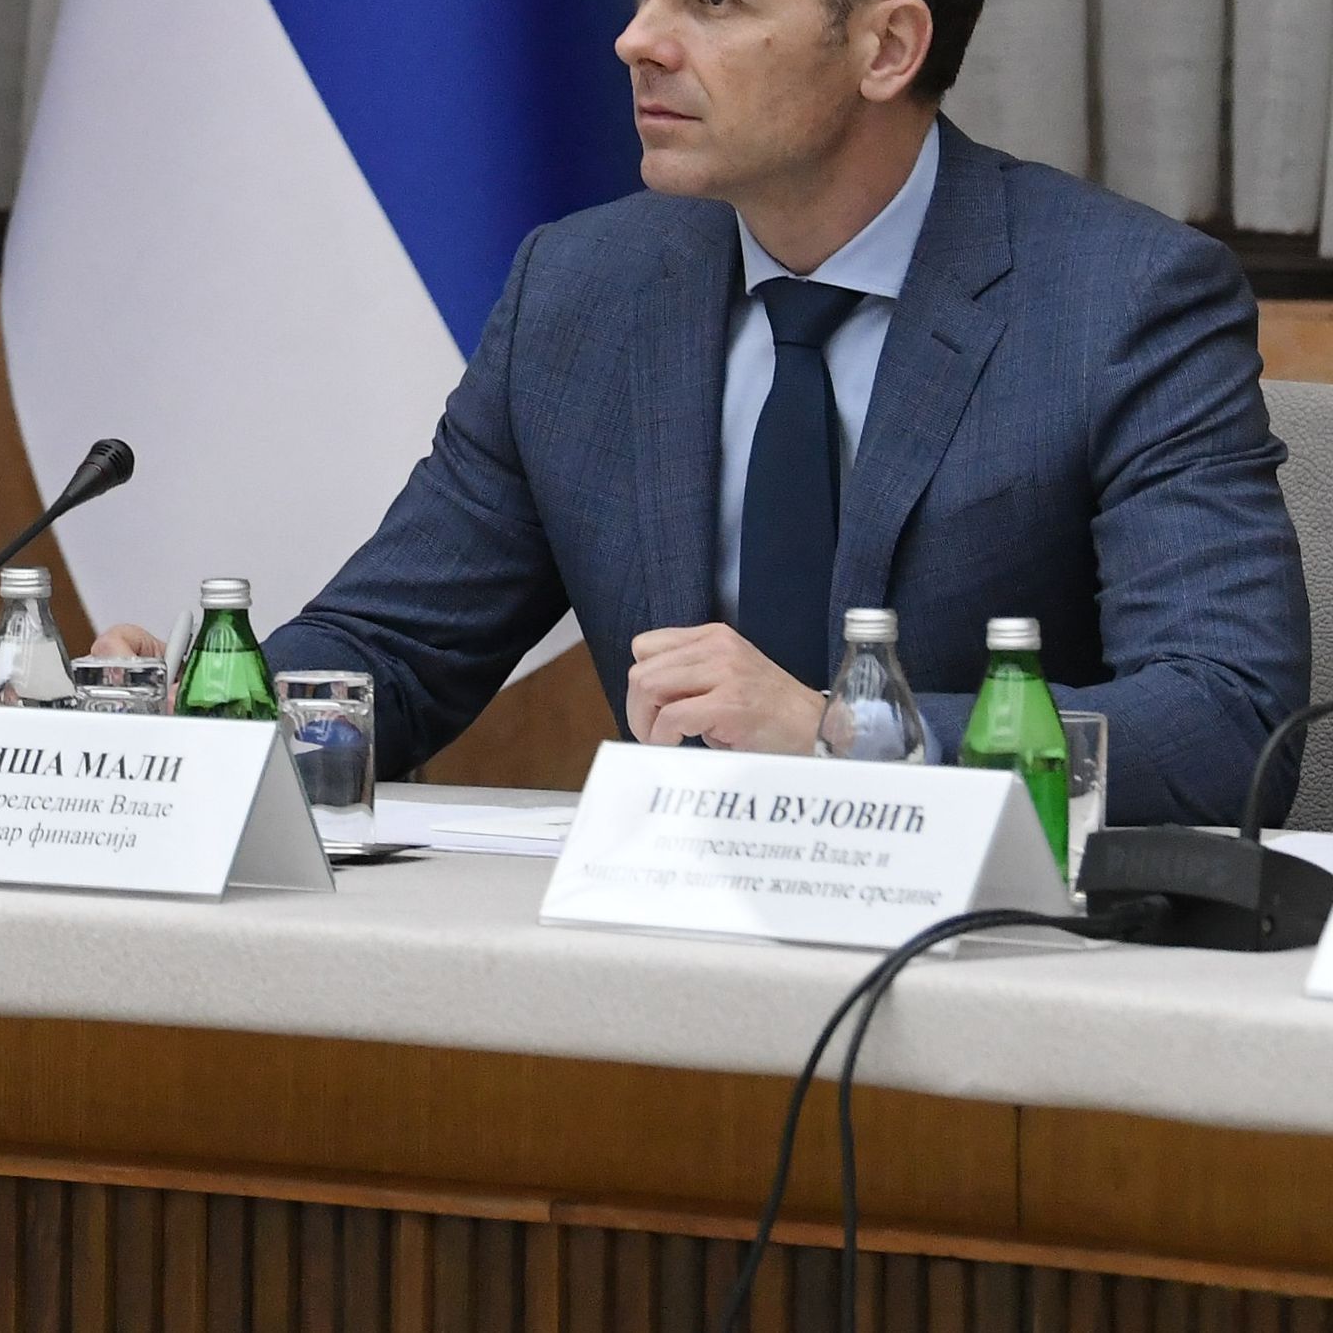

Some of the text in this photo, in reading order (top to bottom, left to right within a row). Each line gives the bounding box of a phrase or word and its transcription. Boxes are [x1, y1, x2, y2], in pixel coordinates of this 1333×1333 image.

[74, 750, 184, 783] МАЛИ
[109, 793, 174, 818] Владе
[648, 785, 926, 835] ИРЕНА ВУЈОВИЋ
[28, 820, 139, 854] финансија
